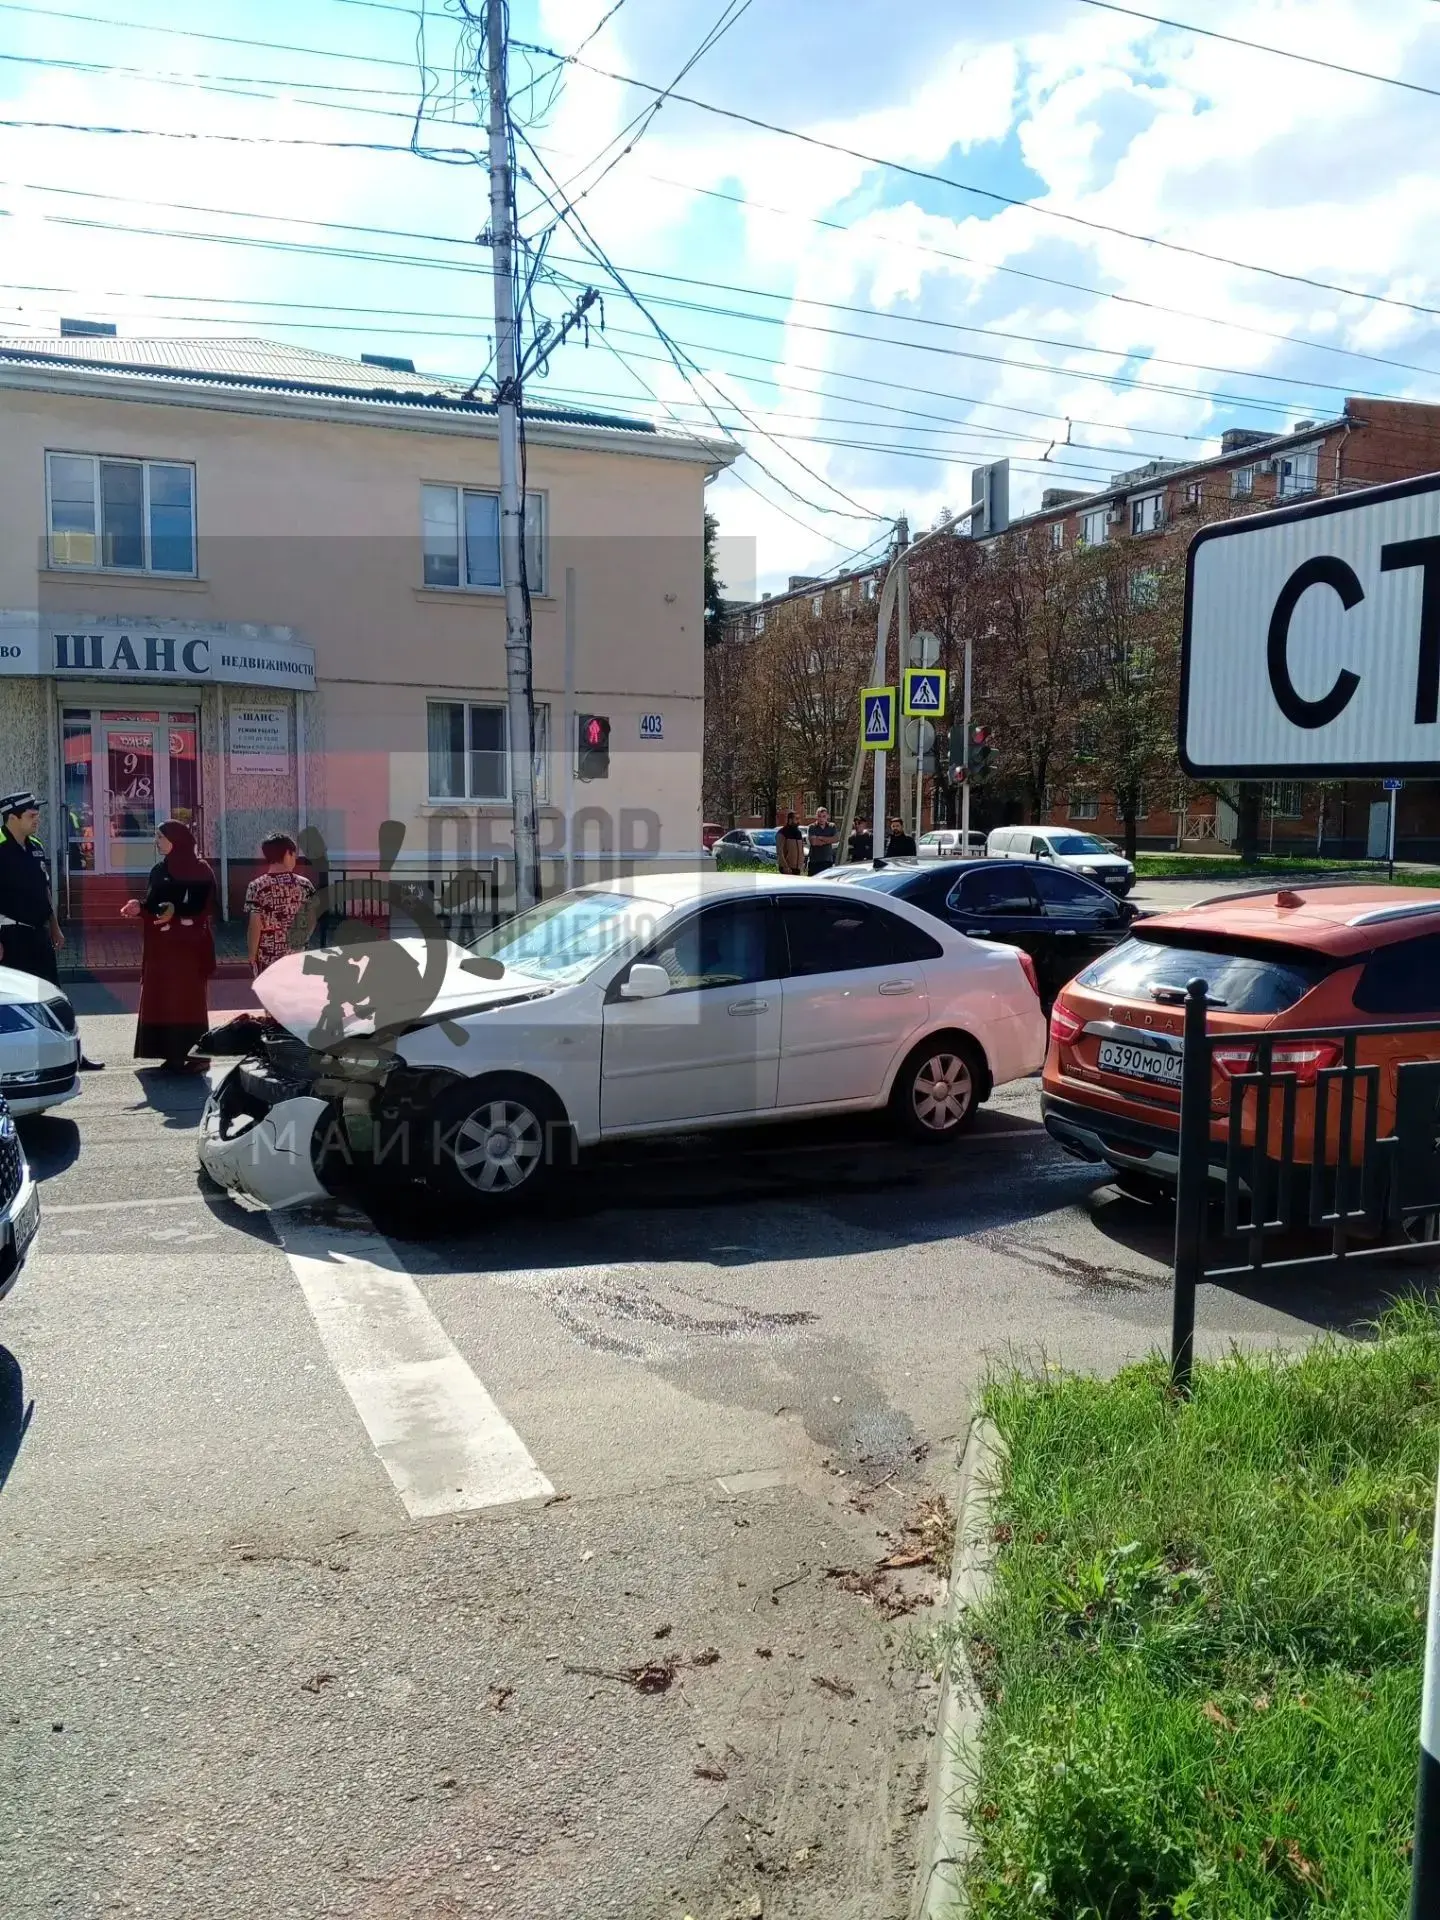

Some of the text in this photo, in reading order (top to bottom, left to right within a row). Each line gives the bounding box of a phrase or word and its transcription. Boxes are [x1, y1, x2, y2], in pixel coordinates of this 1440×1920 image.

[54, 634, 210, 674] ШАНС
[221, 655, 314, 676] НЕДВИЖИМОСТИ
[641, 715, 662, 732] 403
[124, 754, 138, 774] 9
[124, 777, 151, 798] 18
[1108, 1007, 1174, 1029] LADA
[1166, 1056, 1182, 1075] 01
